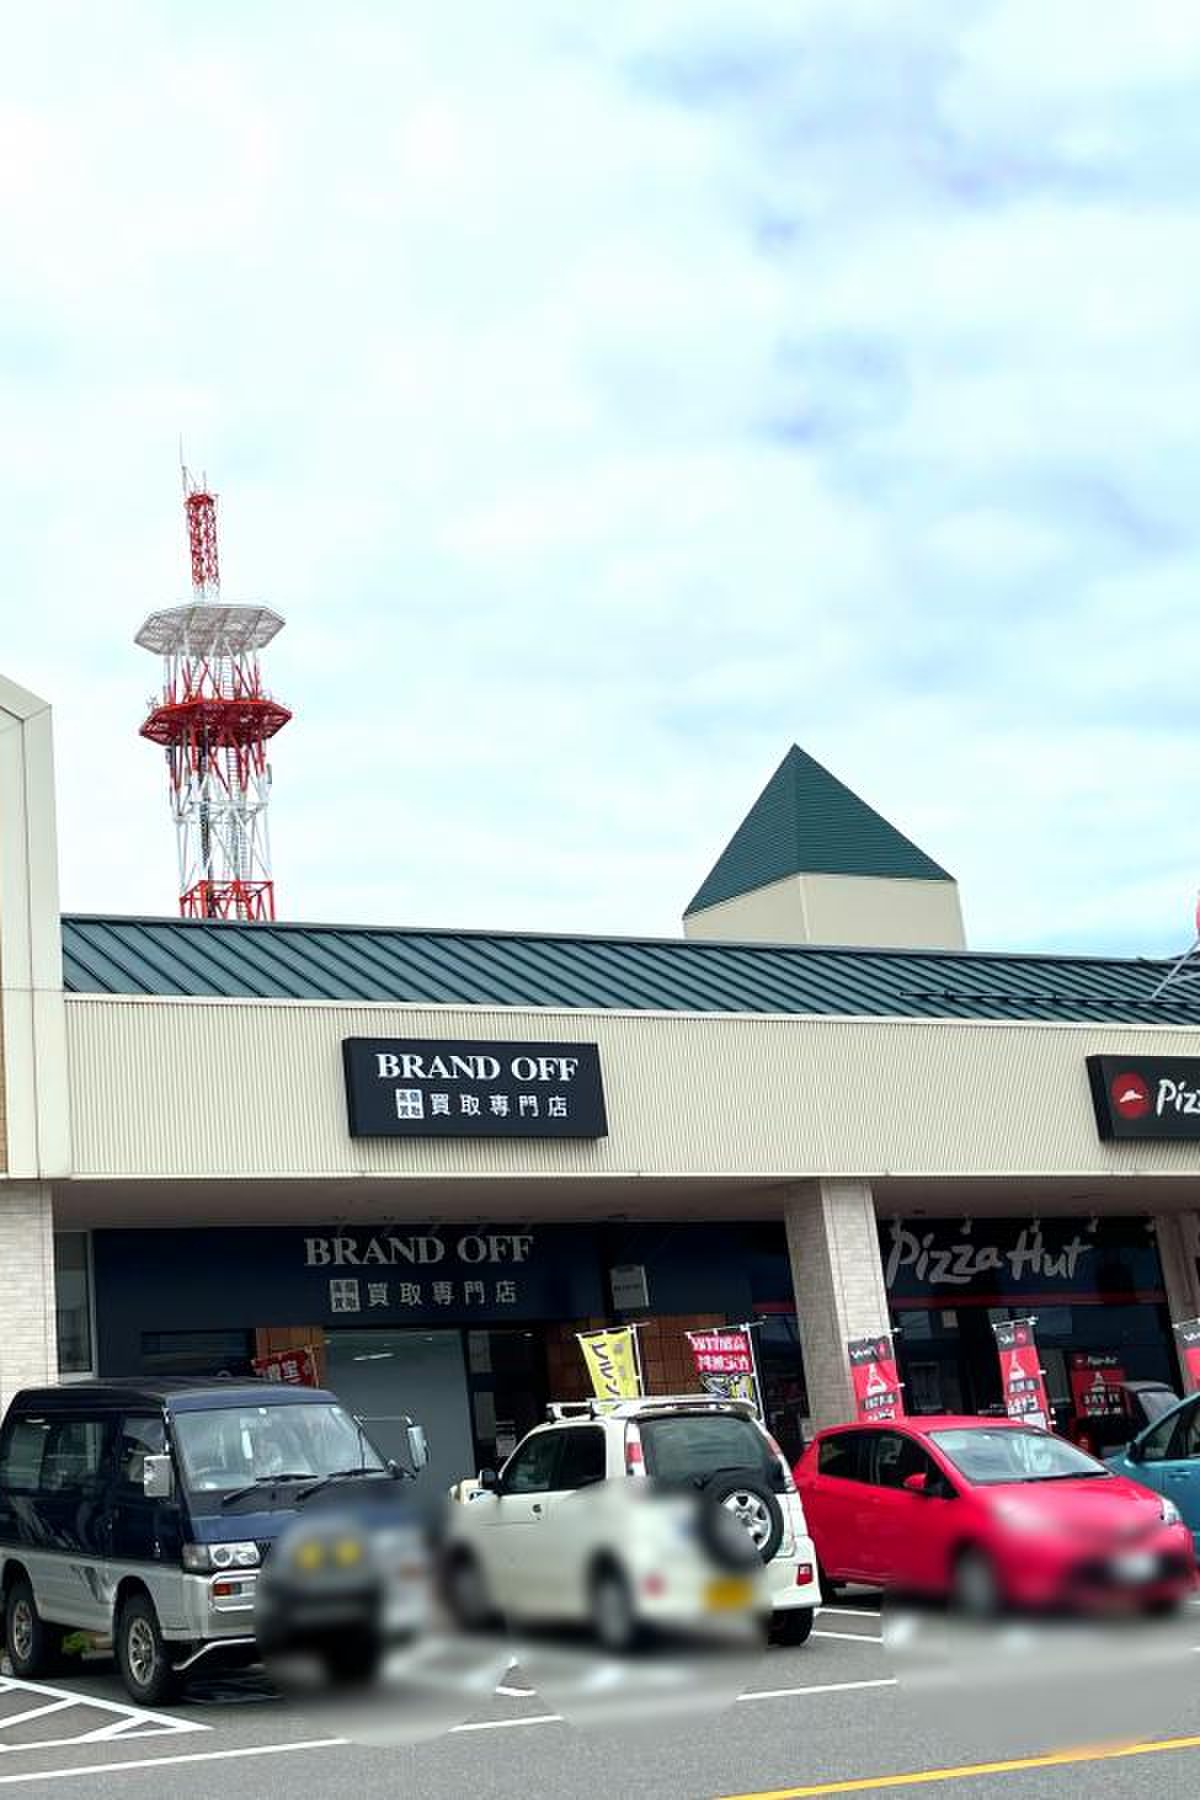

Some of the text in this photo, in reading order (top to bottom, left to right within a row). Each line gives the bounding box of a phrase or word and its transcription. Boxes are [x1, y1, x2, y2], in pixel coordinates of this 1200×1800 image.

[375, 1053, 578, 1082] BRAND OFF
[430, 1092, 569, 1118] 買取専門店
[303, 1234, 534, 1266] BRAND OFF
[886, 1230, 1093, 1289] Pizza Hut
